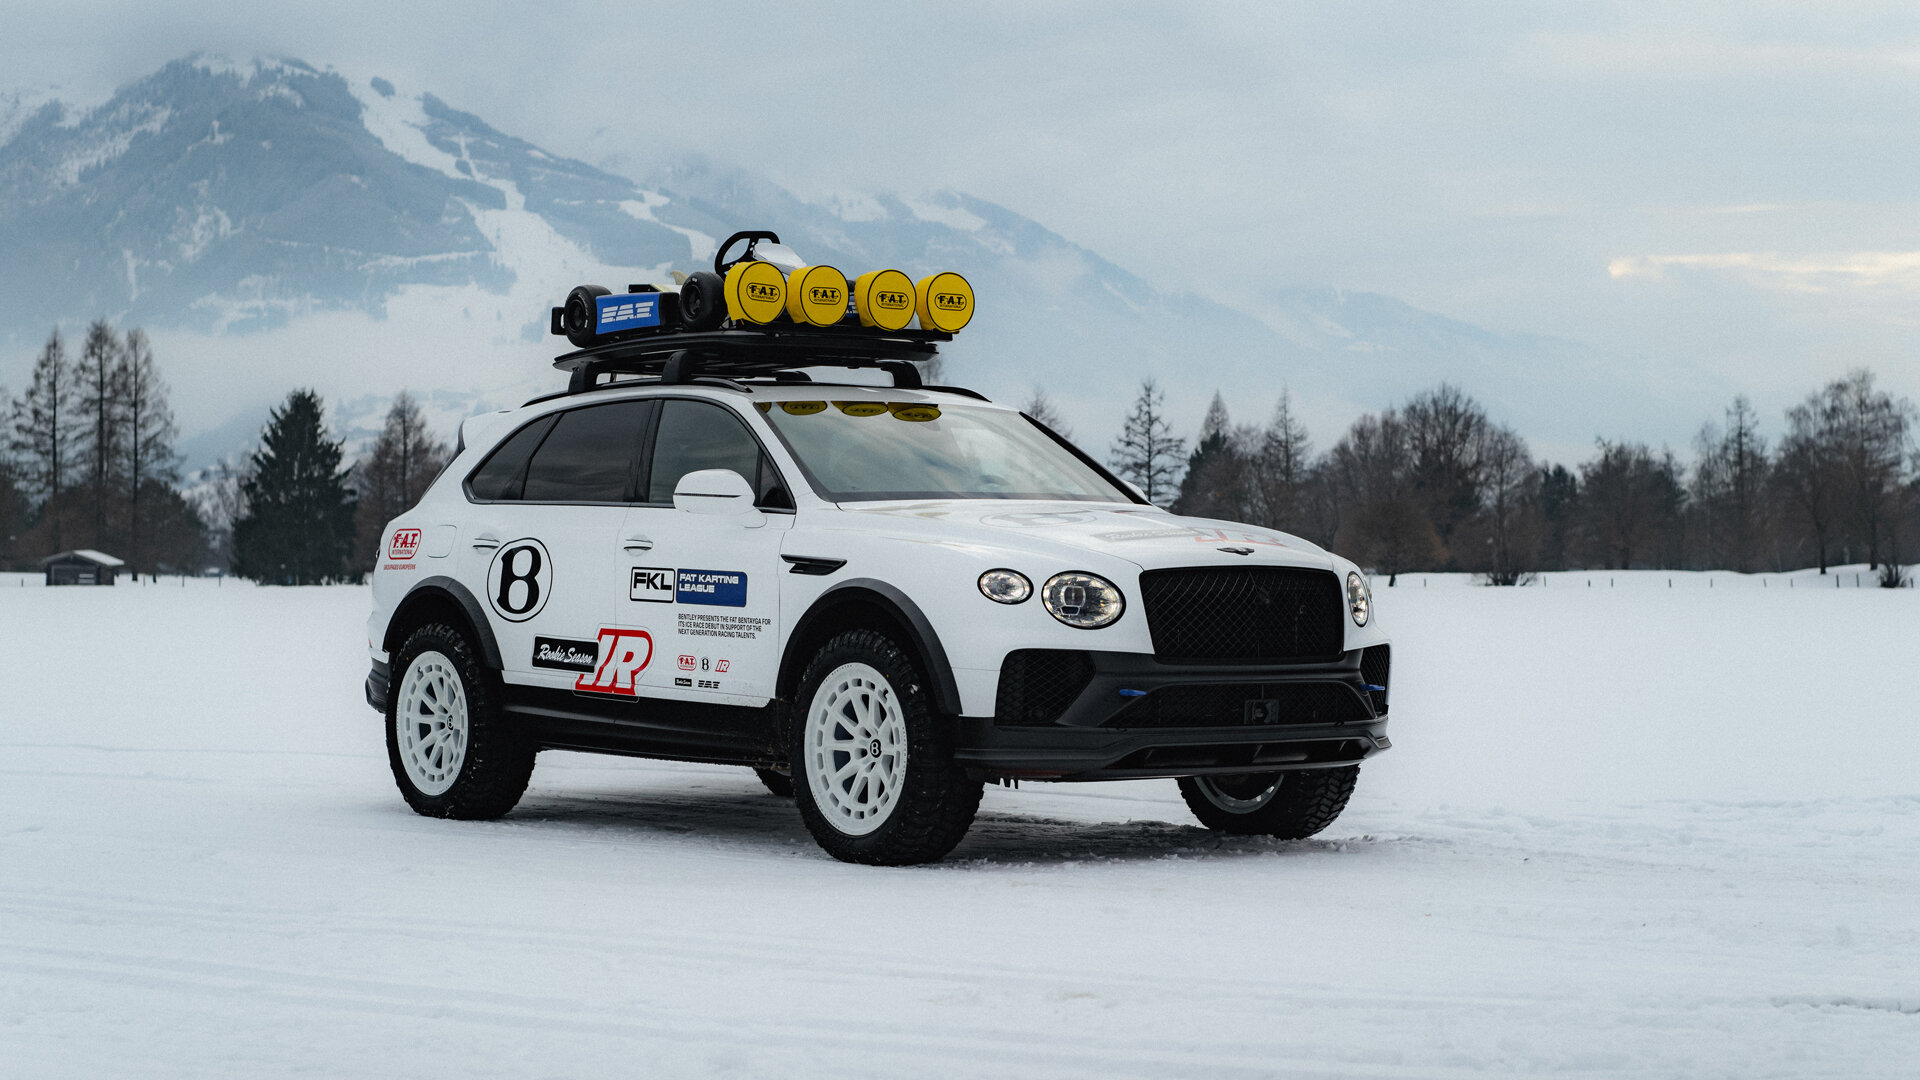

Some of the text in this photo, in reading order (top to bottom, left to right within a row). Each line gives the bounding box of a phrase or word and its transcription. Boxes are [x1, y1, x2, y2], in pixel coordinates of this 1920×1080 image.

[633, 572, 672, 590] FKL
[680, 574, 739, 584] FAT KARTING
[679, 583, 715, 593] LEAGUE
[537, 644, 593, 664] Rookie Season
